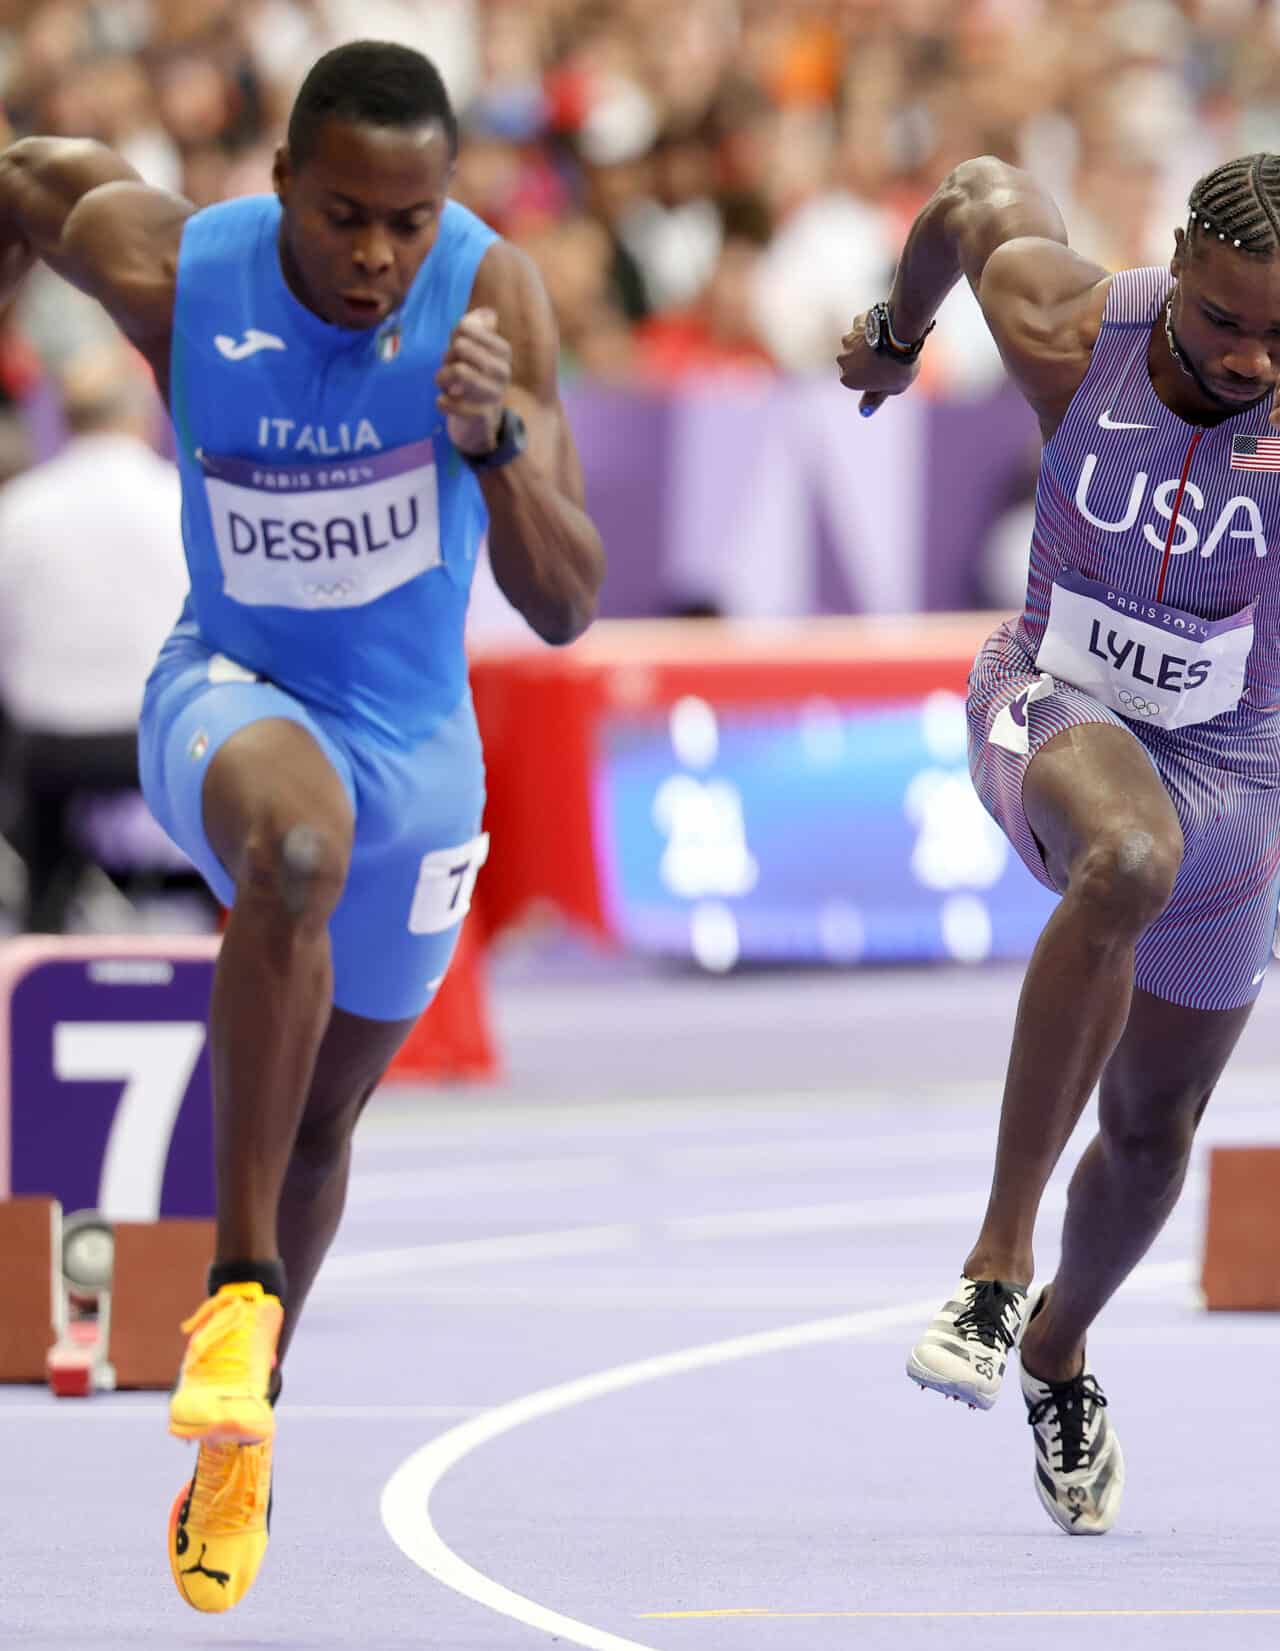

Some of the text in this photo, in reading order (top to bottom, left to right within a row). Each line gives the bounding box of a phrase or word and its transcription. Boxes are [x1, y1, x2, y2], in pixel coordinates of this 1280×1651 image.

[258, 416, 381, 454] ITALIA
[228, 496, 419, 561] DESALU
[1075, 453, 1267, 558] USA
[1106, 591, 1208, 638] PARIS 2024
[1088, 619, 1212, 694] LYLES
[448, 859, 471, 910] 7
[53, 1021, 206, 1224] 7
